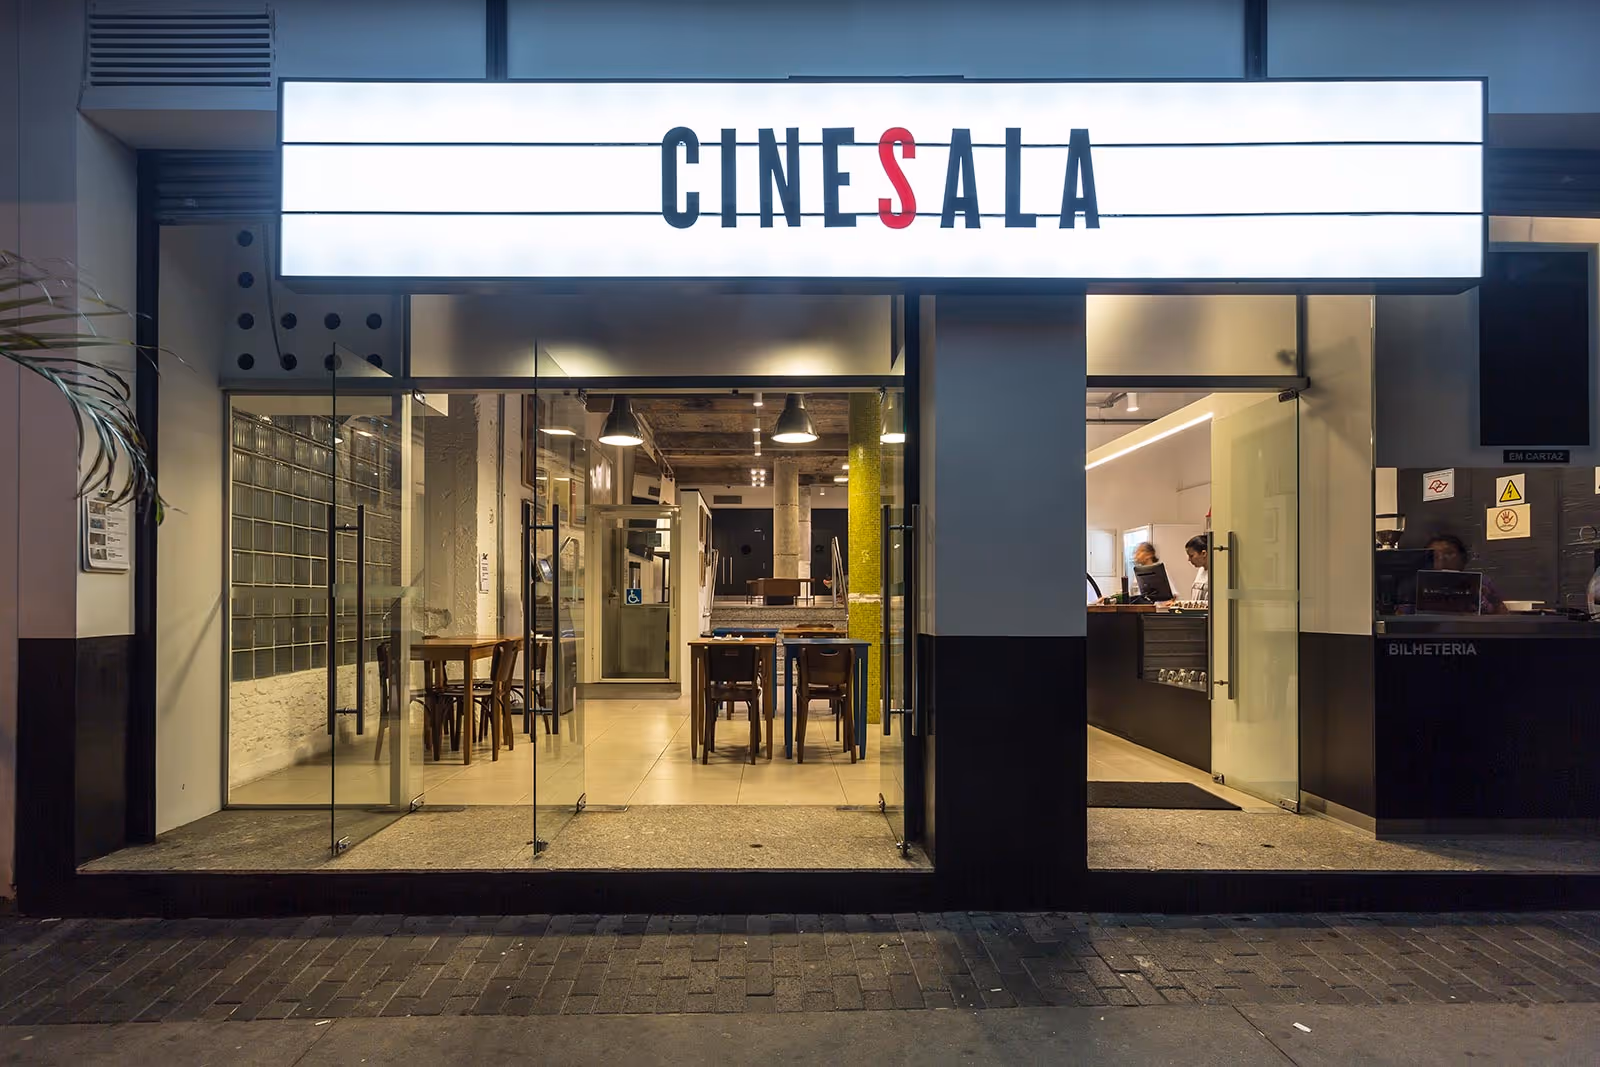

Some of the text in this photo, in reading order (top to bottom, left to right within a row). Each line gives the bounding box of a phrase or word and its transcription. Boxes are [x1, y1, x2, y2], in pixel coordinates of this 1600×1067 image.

[661, 126, 1100, 229] CINESALA
[1508, 452, 1564, 461] EM CARTAZ
[1388, 643, 1478, 656] BILHETERIA
